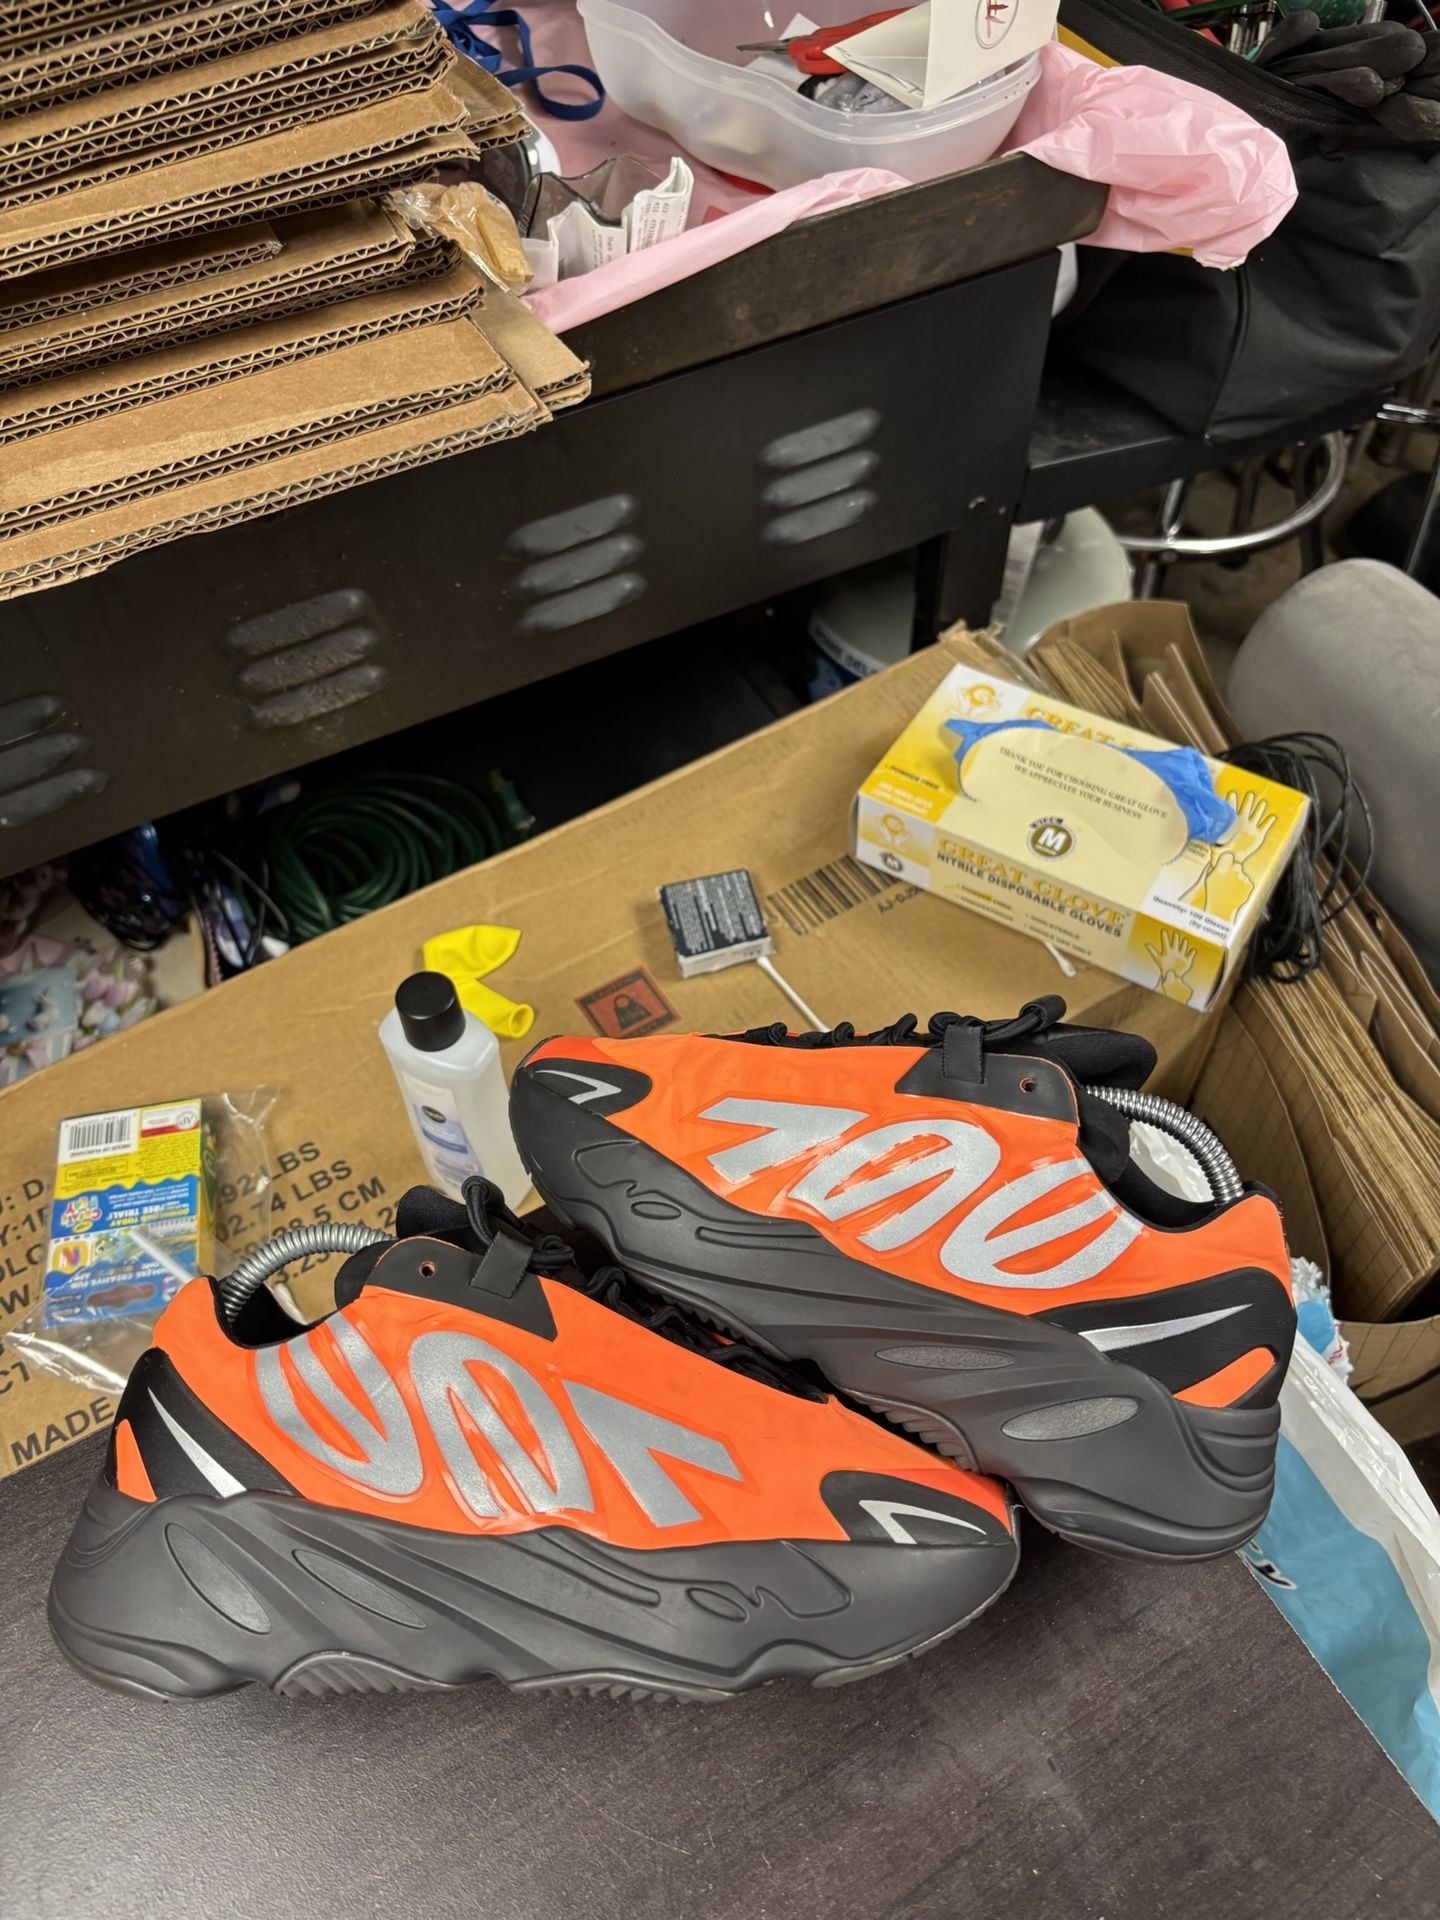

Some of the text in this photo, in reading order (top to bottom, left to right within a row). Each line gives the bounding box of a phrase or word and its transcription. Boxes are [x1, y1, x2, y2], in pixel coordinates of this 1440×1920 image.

[999, 746, 1168, 819] THANK YOU FOR CHOOSING GREAT GLOVE
[1014, 764, 1143, 820] WE APPRECIATE YOUR BUSINESS
[1037, 827, 1067, 851] M
[936, 852, 1122, 938] NITRILE DISPOSABLE GLOVES
[938, 838, 1125, 929] GREAT GLOVE
[291, 1160, 353, 1201] LBS
[338, 1175, 386, 1212] CM
[10, 1396, 115, 1466] MADE
